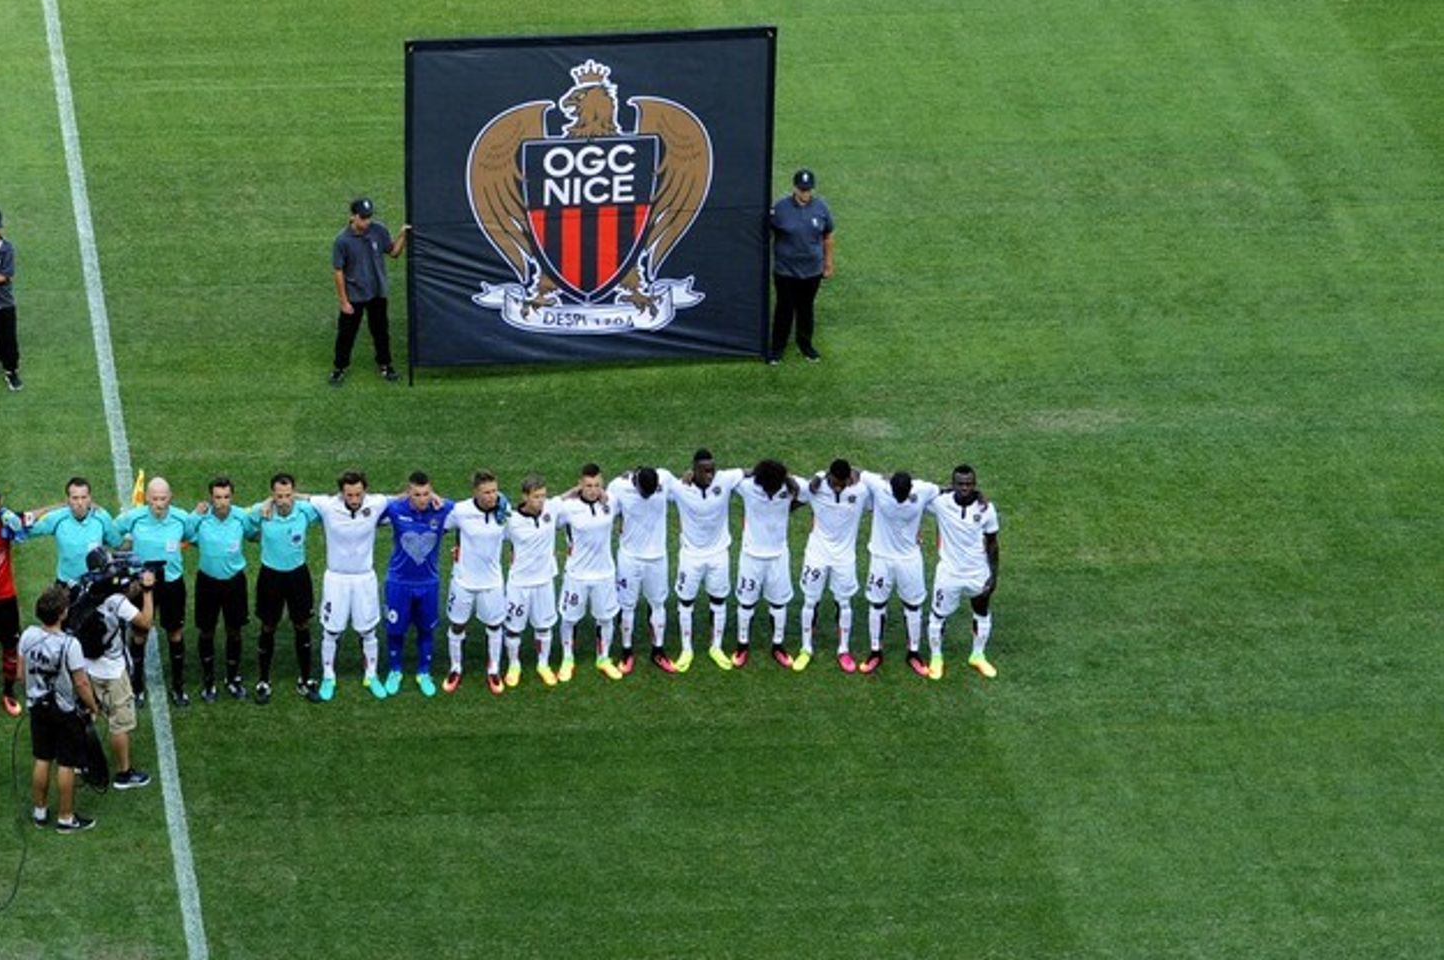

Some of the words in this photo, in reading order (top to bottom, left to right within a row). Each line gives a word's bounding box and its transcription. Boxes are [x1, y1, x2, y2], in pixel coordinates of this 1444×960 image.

[543, 144, 635, 177] OGC
[543, 174, 635, 206] NICE
[508, 602, 524, 617] 26
